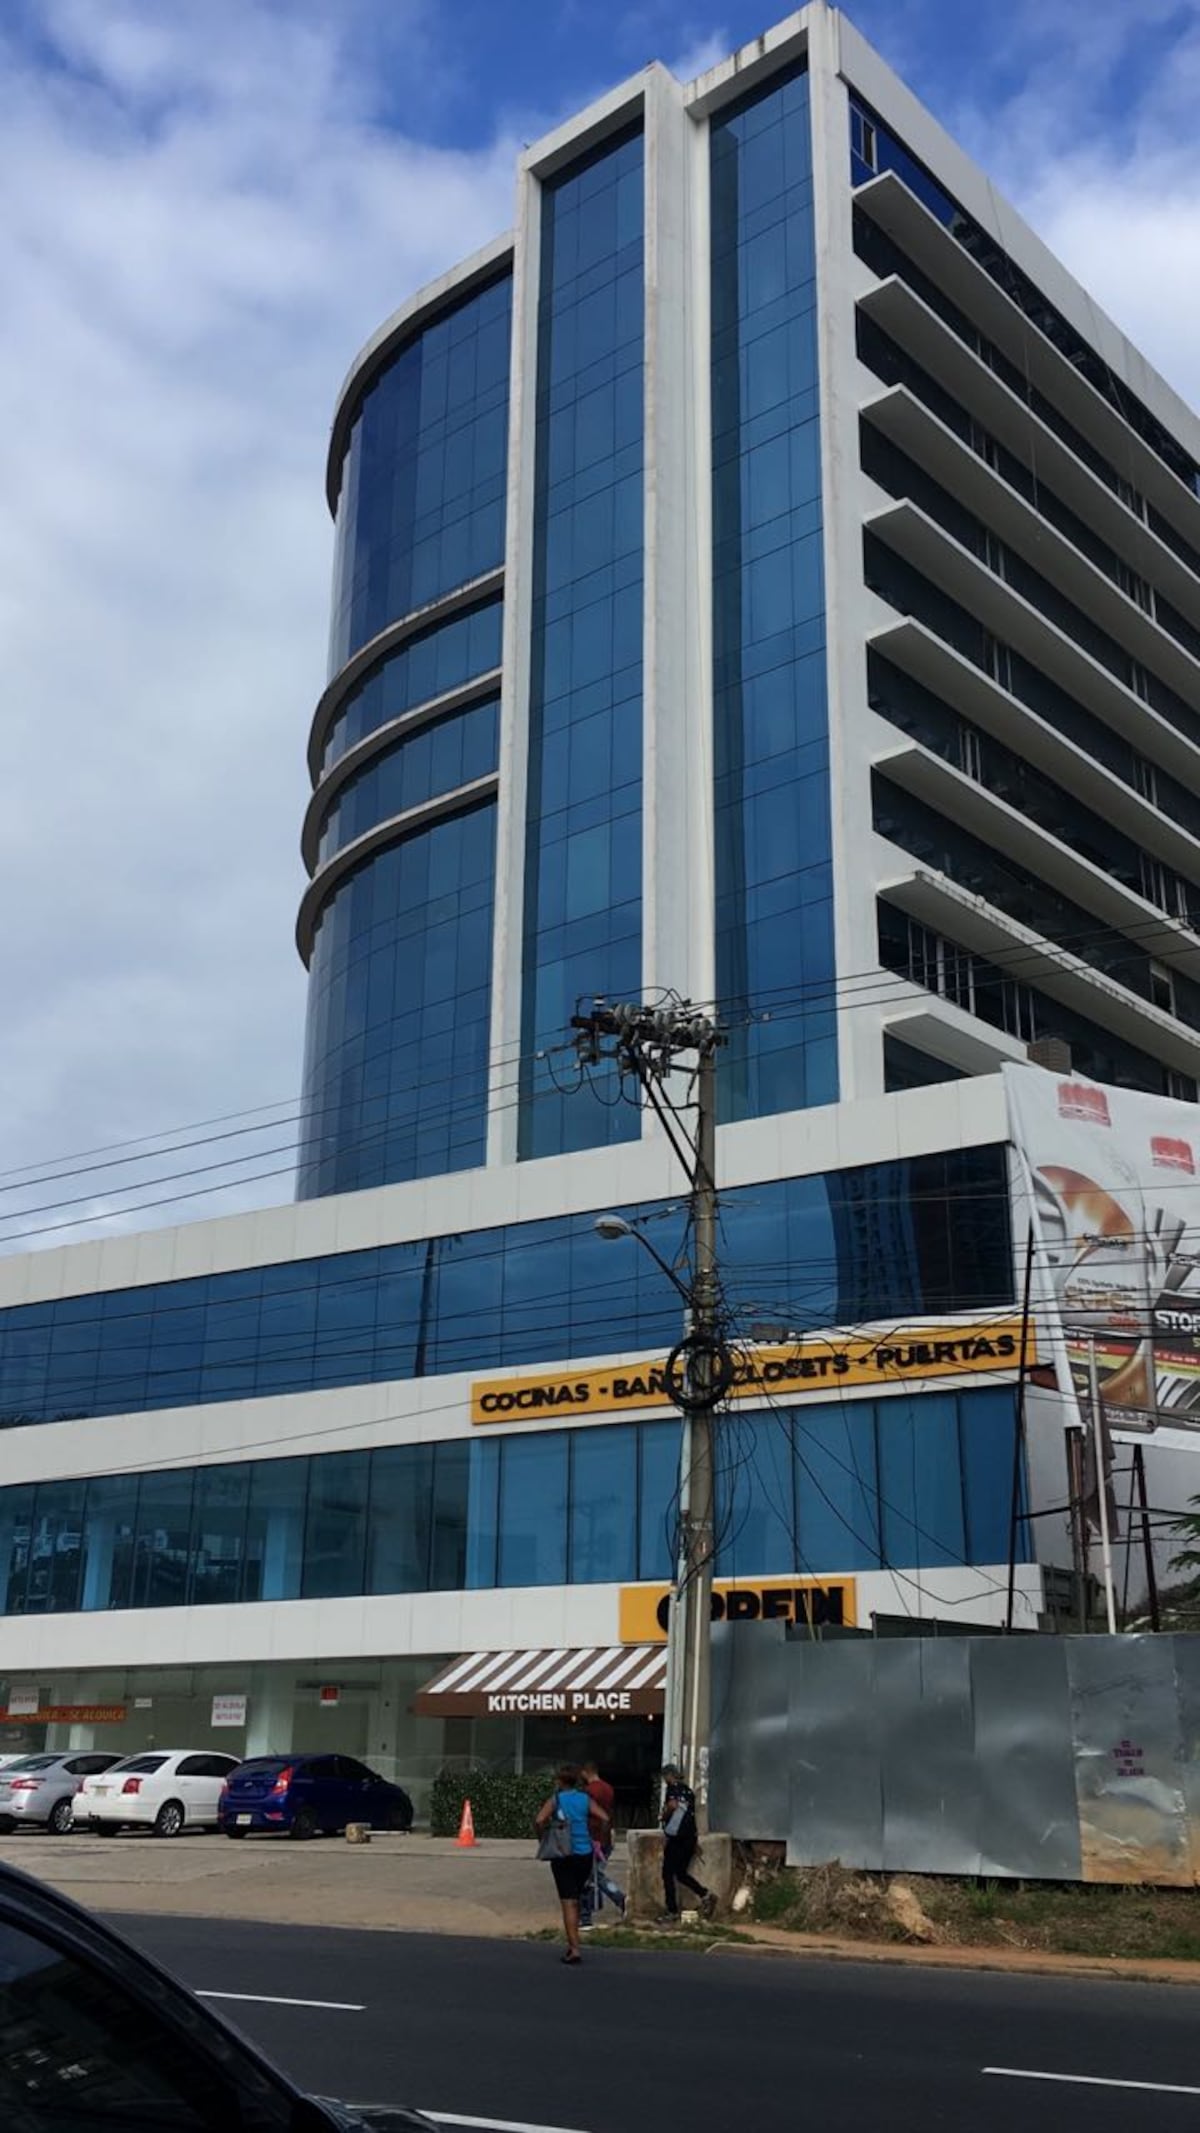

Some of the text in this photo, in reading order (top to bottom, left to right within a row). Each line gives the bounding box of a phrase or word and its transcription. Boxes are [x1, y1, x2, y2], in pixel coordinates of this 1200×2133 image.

[480, 1335, 1015, 1412] COCINAS BAÑO CLOSETS PUERTAS
[488, 1693, 631, 1711] KITCHEN PLACE
